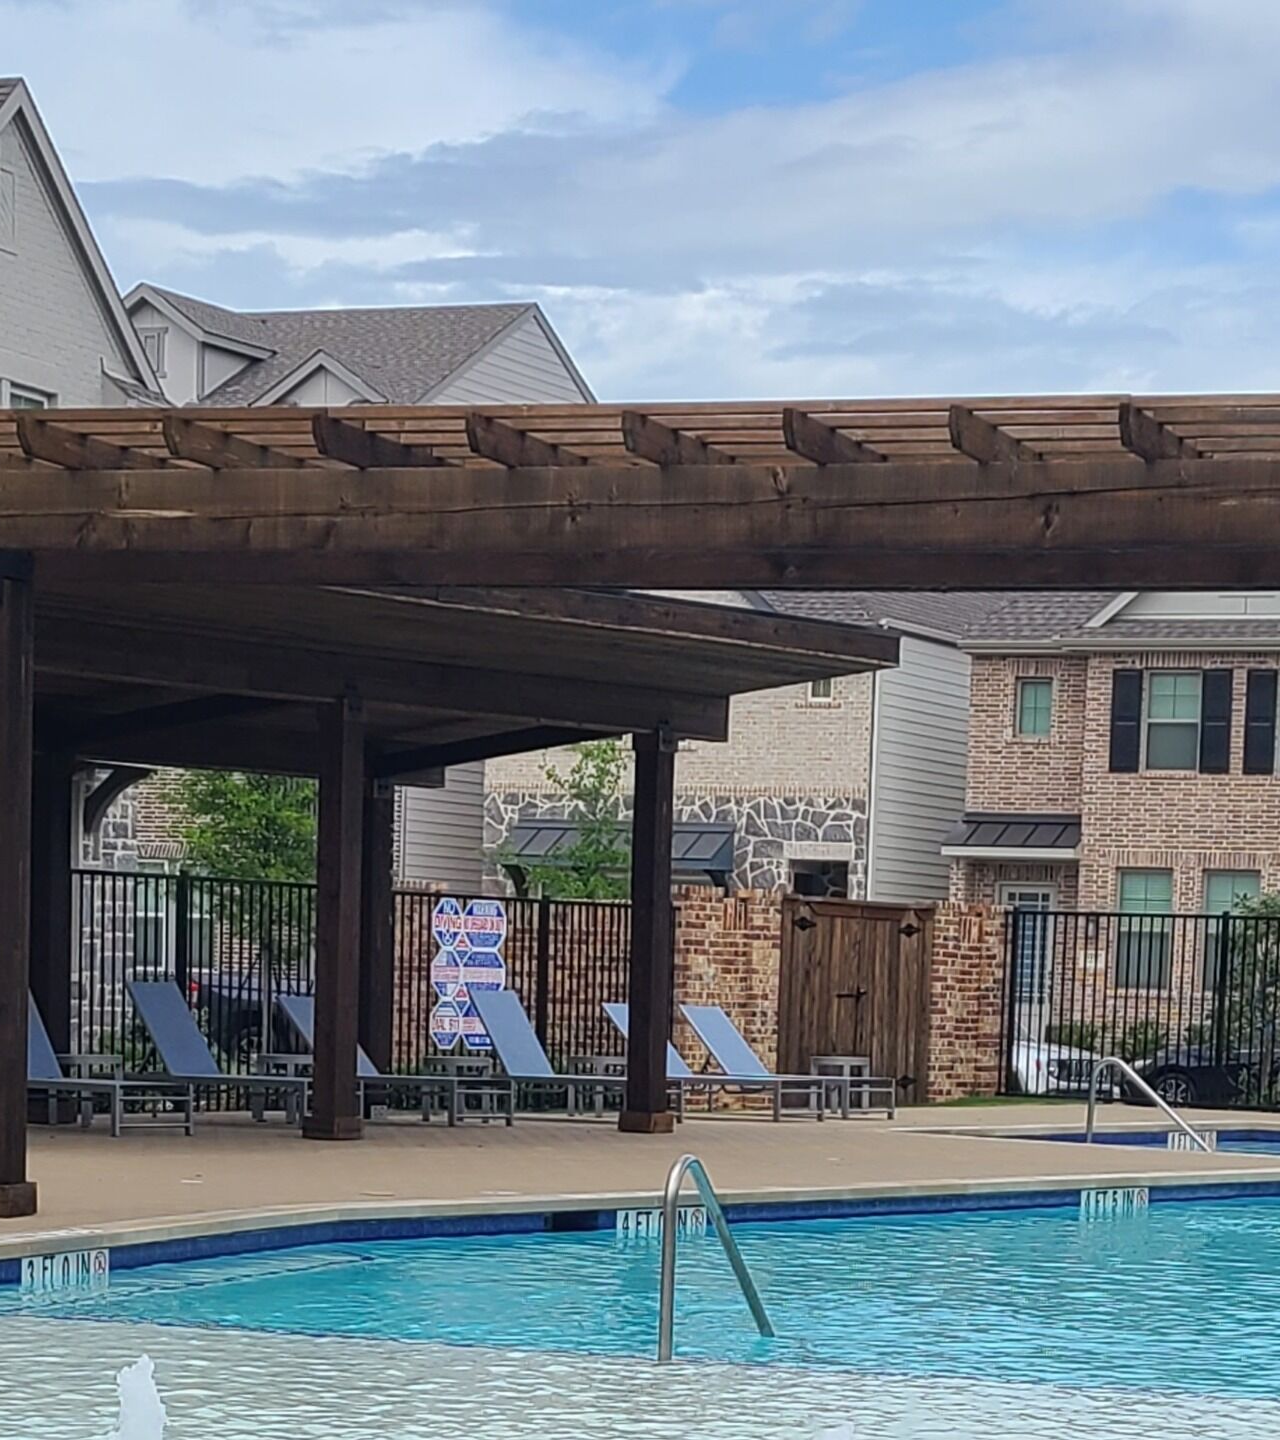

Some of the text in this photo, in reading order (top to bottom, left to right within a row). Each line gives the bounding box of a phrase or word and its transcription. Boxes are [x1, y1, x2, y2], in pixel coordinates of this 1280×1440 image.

[1095, 1190, 1108, 1217] FT
[1123, 1189, 1135, 1218] IN
[622, 1212, 629, 1239] 4
[636, 1211, 652, 1238] FT
[27, 1259, 34, 1289] 3
[42, 1255, 55, 1288] FT
[76, 1252, 90, 1286] IN
